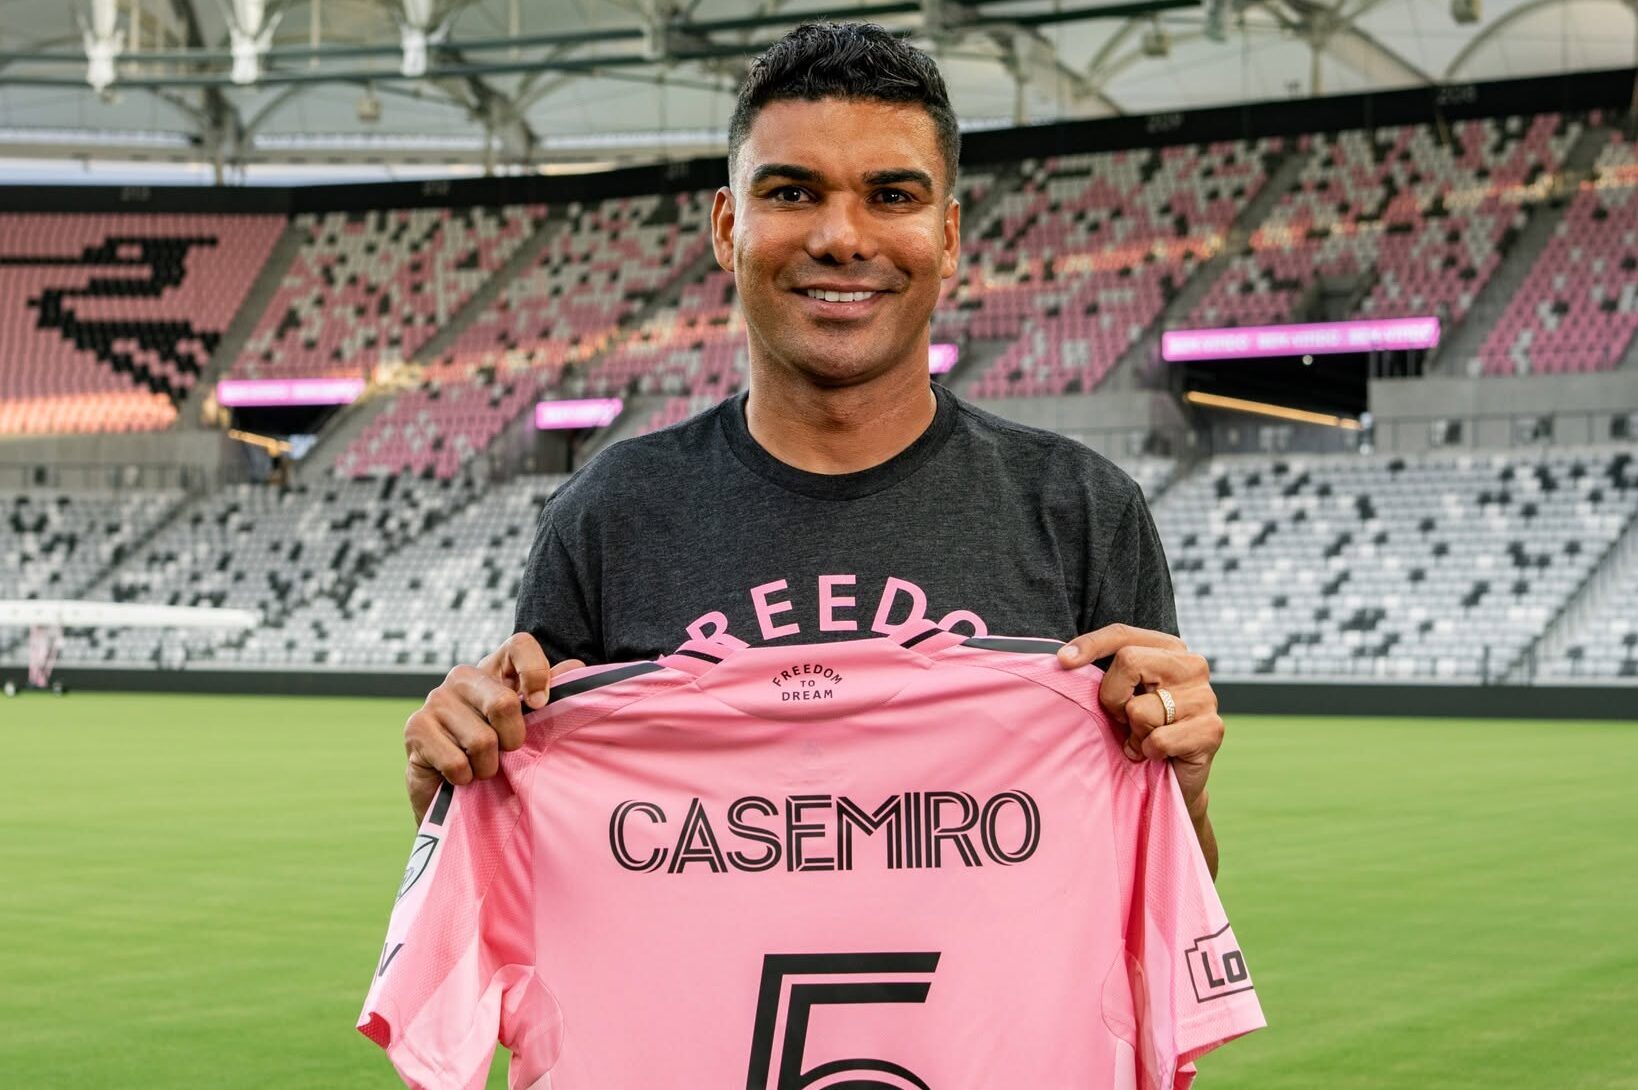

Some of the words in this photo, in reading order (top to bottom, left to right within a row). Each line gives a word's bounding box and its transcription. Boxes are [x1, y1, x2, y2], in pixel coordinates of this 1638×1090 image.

[684, 574, 988, 649] REED
[772, 664, 843, 687] FREEDOM
[800, 680, 816, 688] TO
[782, 689, 833, 701] DREAM
[609, 789, 1041, 874] CASEMIRO
